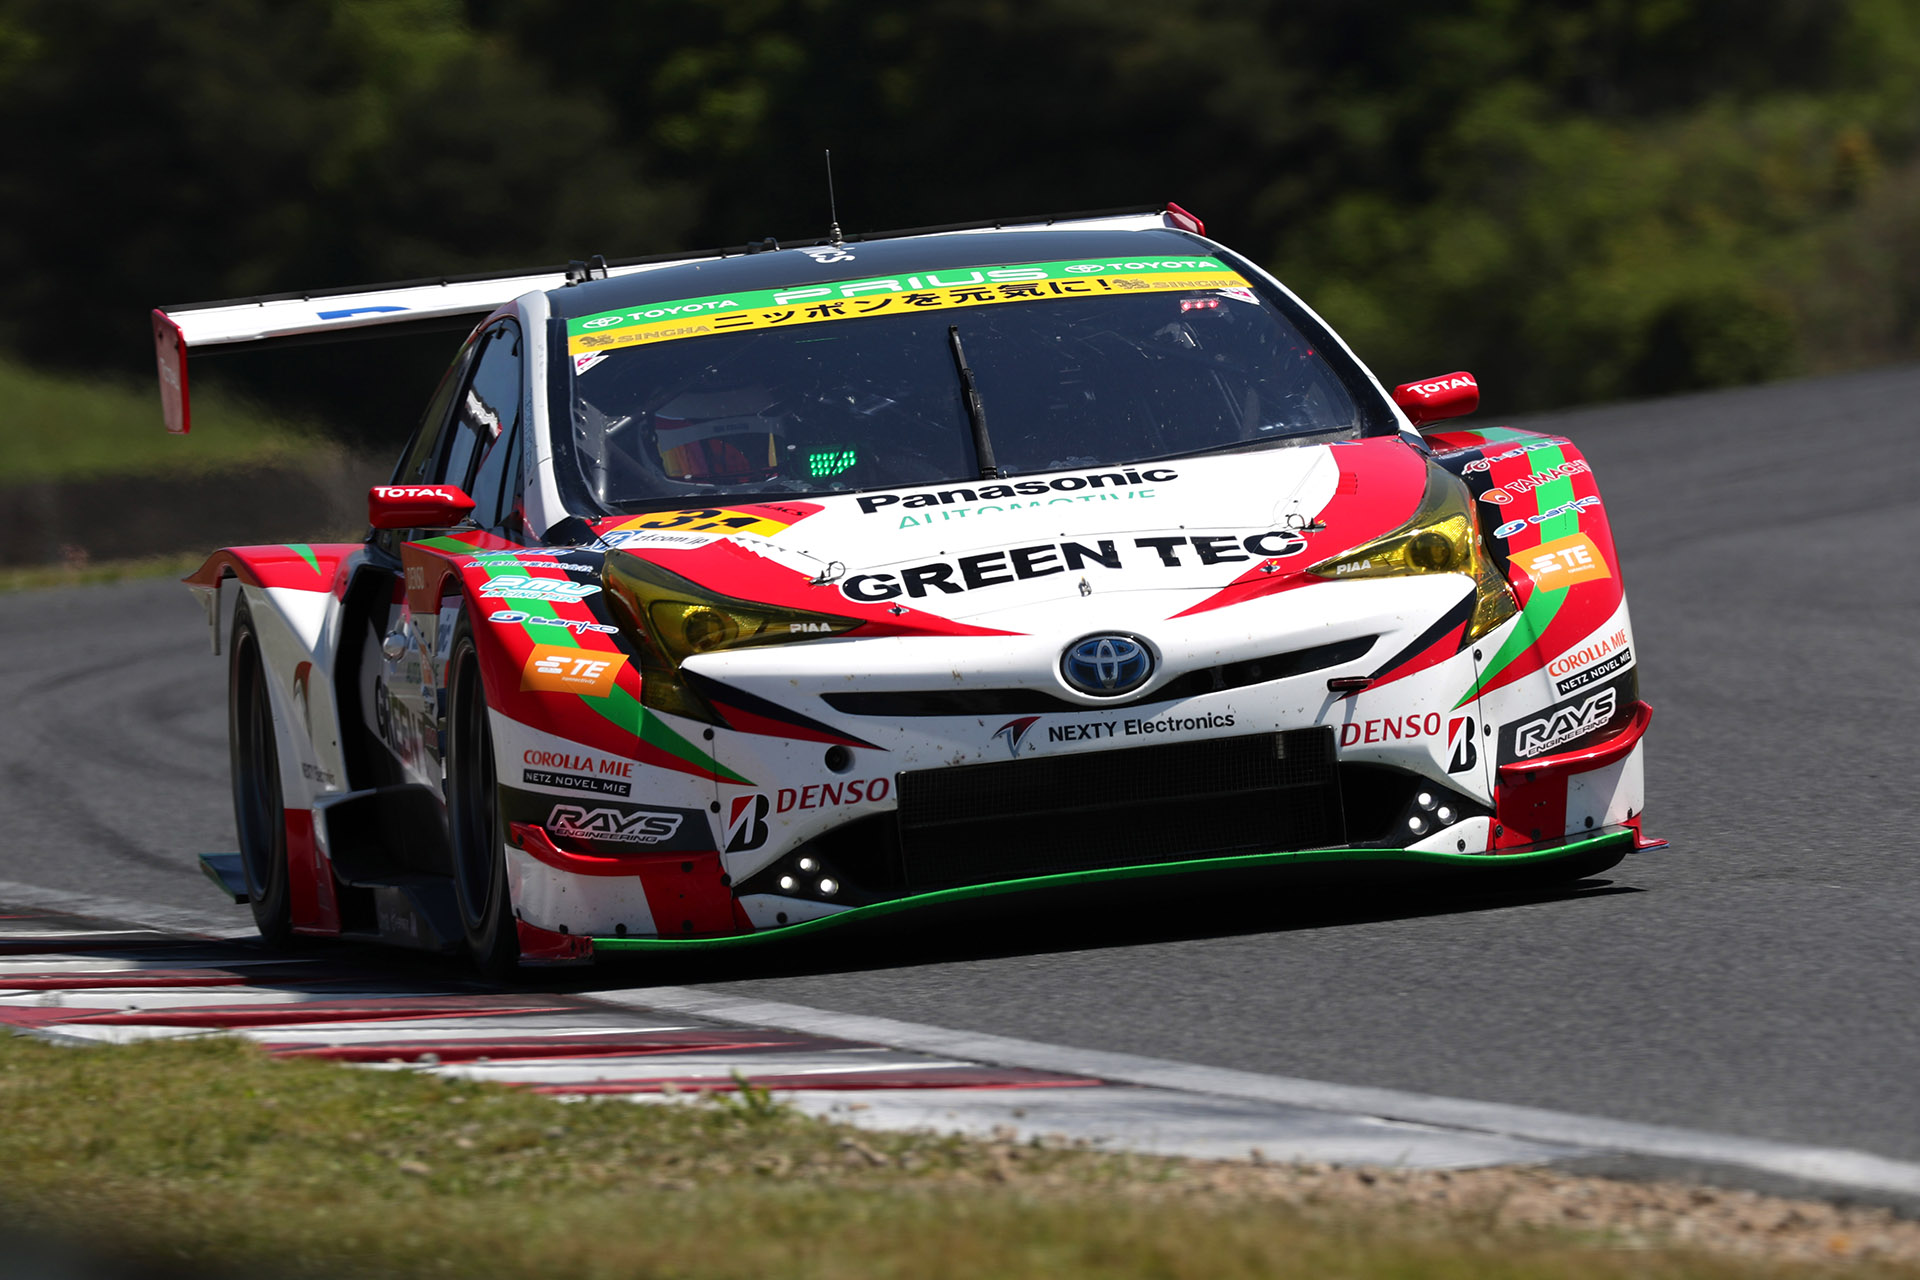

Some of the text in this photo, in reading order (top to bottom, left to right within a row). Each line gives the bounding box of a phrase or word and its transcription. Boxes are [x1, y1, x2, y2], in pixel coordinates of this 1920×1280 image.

[1106, 261, 1219, 271] TOYOTA
[773, 267, 1049, 306] PRIUS
[1152, 279, 1245, 289] SINGHA
[627, 299, 739, 321] TOYOTA
[617, 325, 711, 343] SINGHA
[1406, 376, 1478, 398] TOTAL
[374, 487, 454, 501] TOTAL
[856, 467, 1179, 515] Panasonic
[840, 530, 1306, 603] GREEN TEC
[1336, 559, 1372, 575] PIAA
[1556, 544, 1593, 567] TE
[789, 622, 832, 634] PIAA
[1548, 628, 1628, 677] COROLLA MIE
[570, 658, 611, 679] TE
[1560, 650, 1631, 692] NETZ NOVEL MIE
[1048, 712, 1236, 742] NEXTY Electronics
[1339, 712, 1442, 747] DENSO
[1518, 690, 1615, 753] RAYS
[1528, 717, 1609, 756] ENGINEERING
[523, 749, 635, 778] COROLLA MIE
[525, 772, 627, 794] NETZ NOVEL MIE
[776, 777, 891, 814] DENSO
[549, 807, 681, 837] RAYS
[556, 828, 659, 843] ENGINEERING
